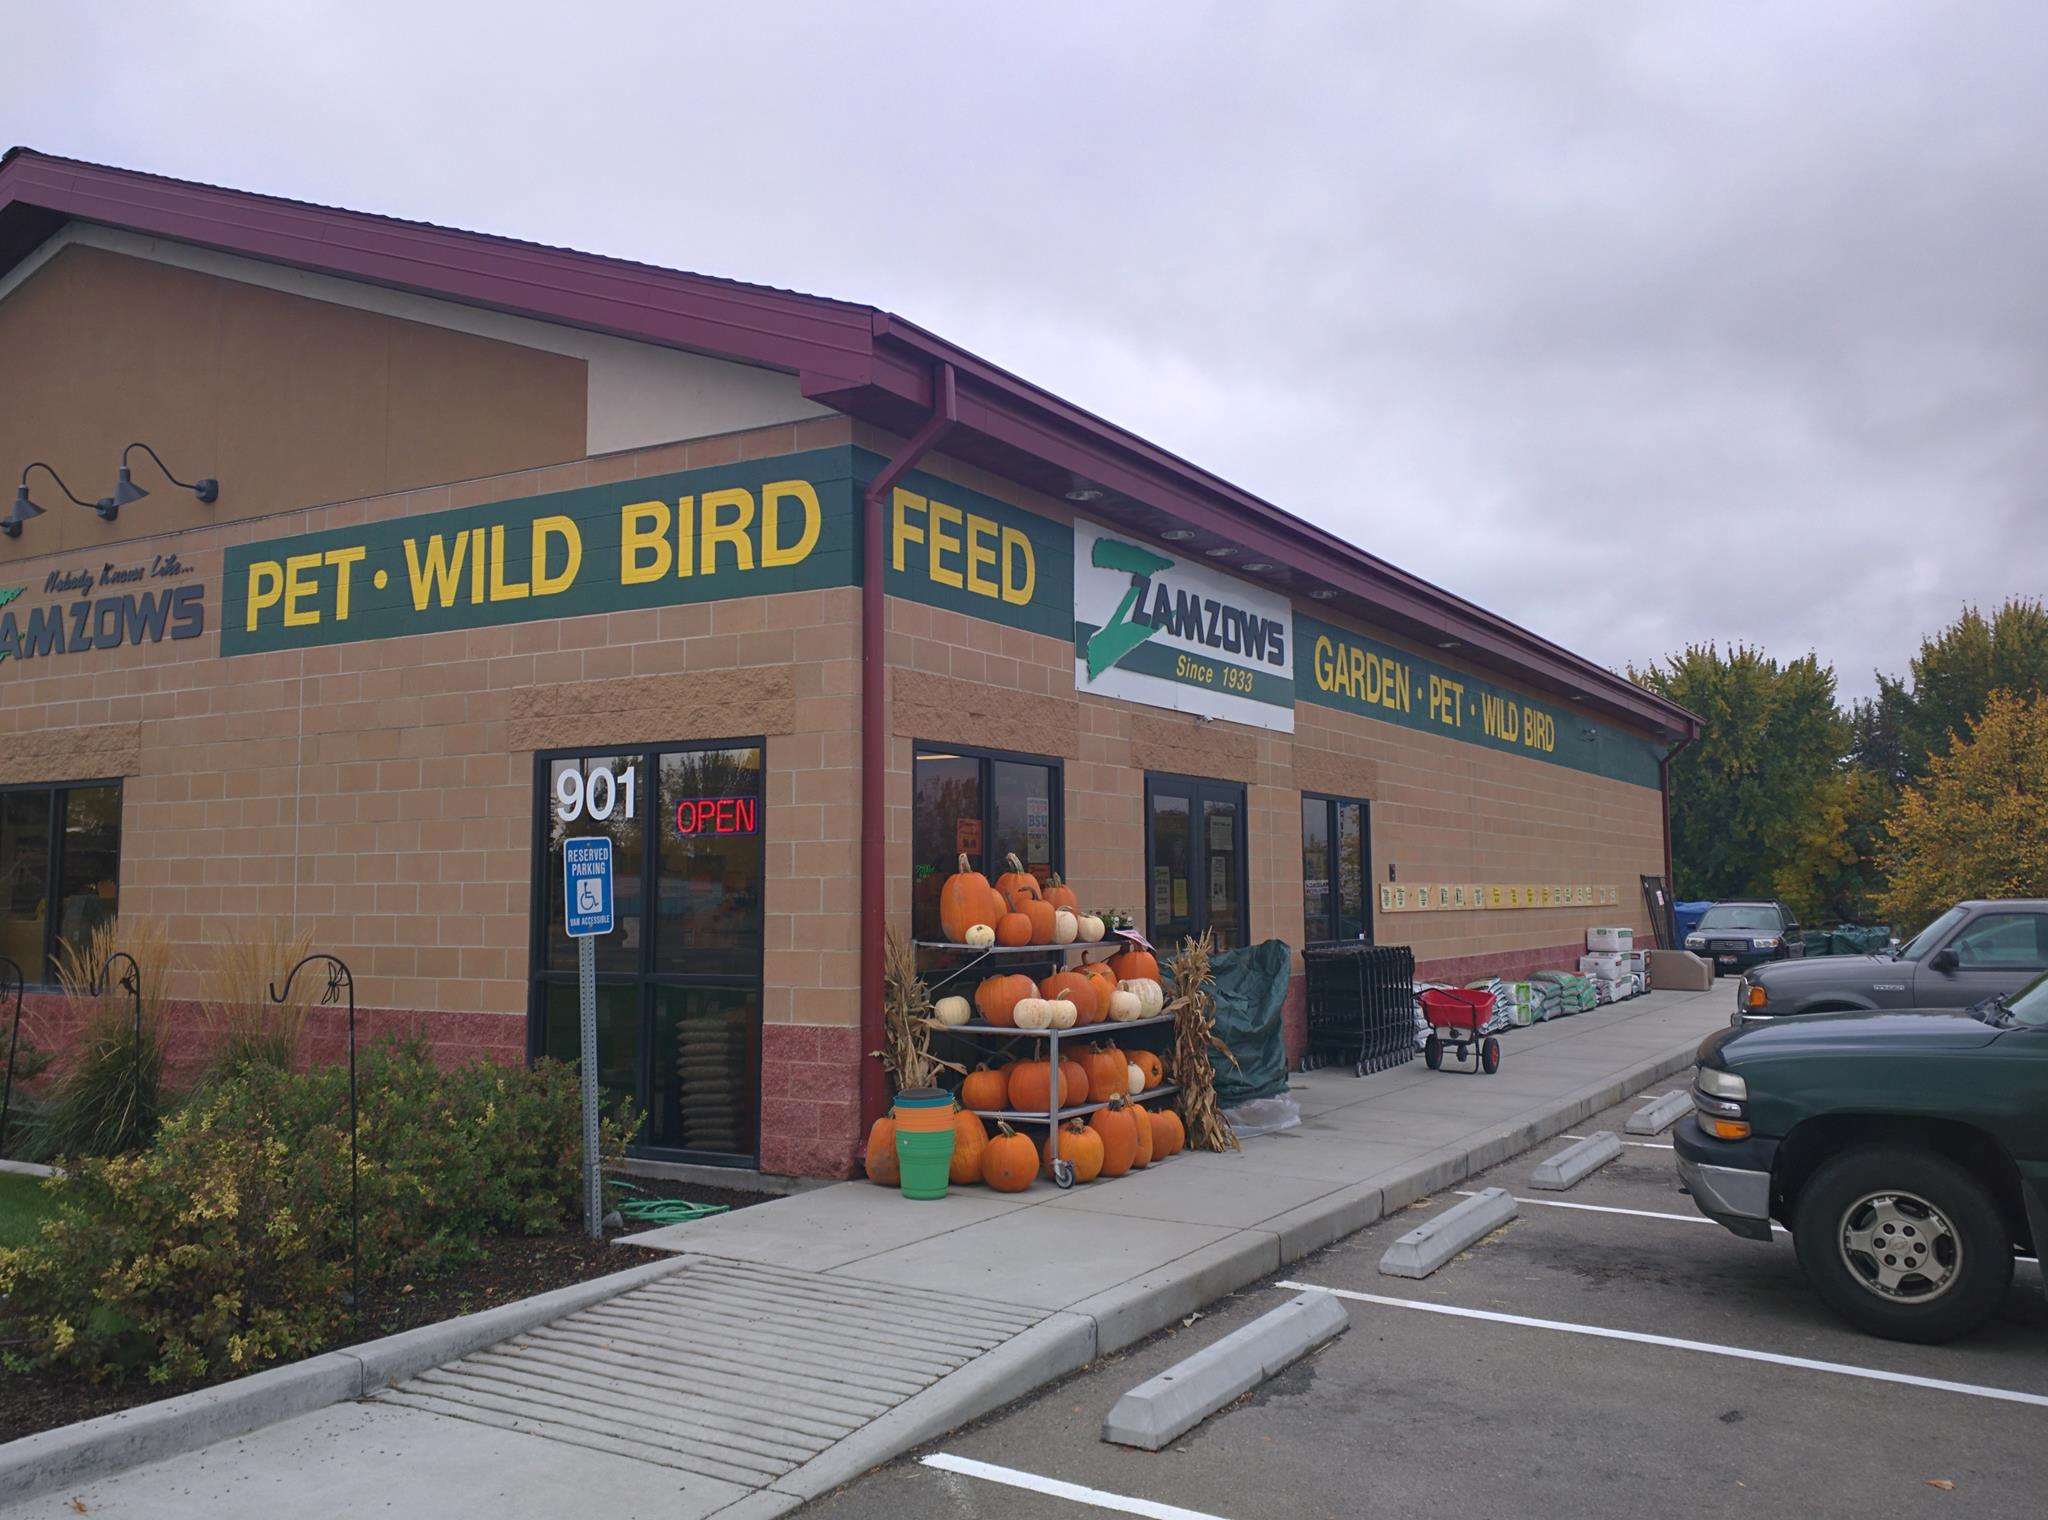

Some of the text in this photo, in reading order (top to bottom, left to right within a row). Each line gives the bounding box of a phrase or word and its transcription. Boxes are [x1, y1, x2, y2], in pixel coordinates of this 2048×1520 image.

[246, 479, 821, 632] PET WILD BIRD
[893, 486, 1035, 606] FEED
[0, 584, 205, 660] AMZOWS
[1131, 574, 1285, 666] ZAMZOWS
[1176, 654, 1253, 692] Since 1933
[1314, 635, 1555, 752] GARDEN PET WILD BIRD
[556, 766, 636, 822] 901
[677, 799, 755, 833] OPEN
[567, 848, 609, 863] RESERVED
[572, 862, 606, 876] PARKING
[569, 914, 611, 927] VAN ACCESSIBLE
